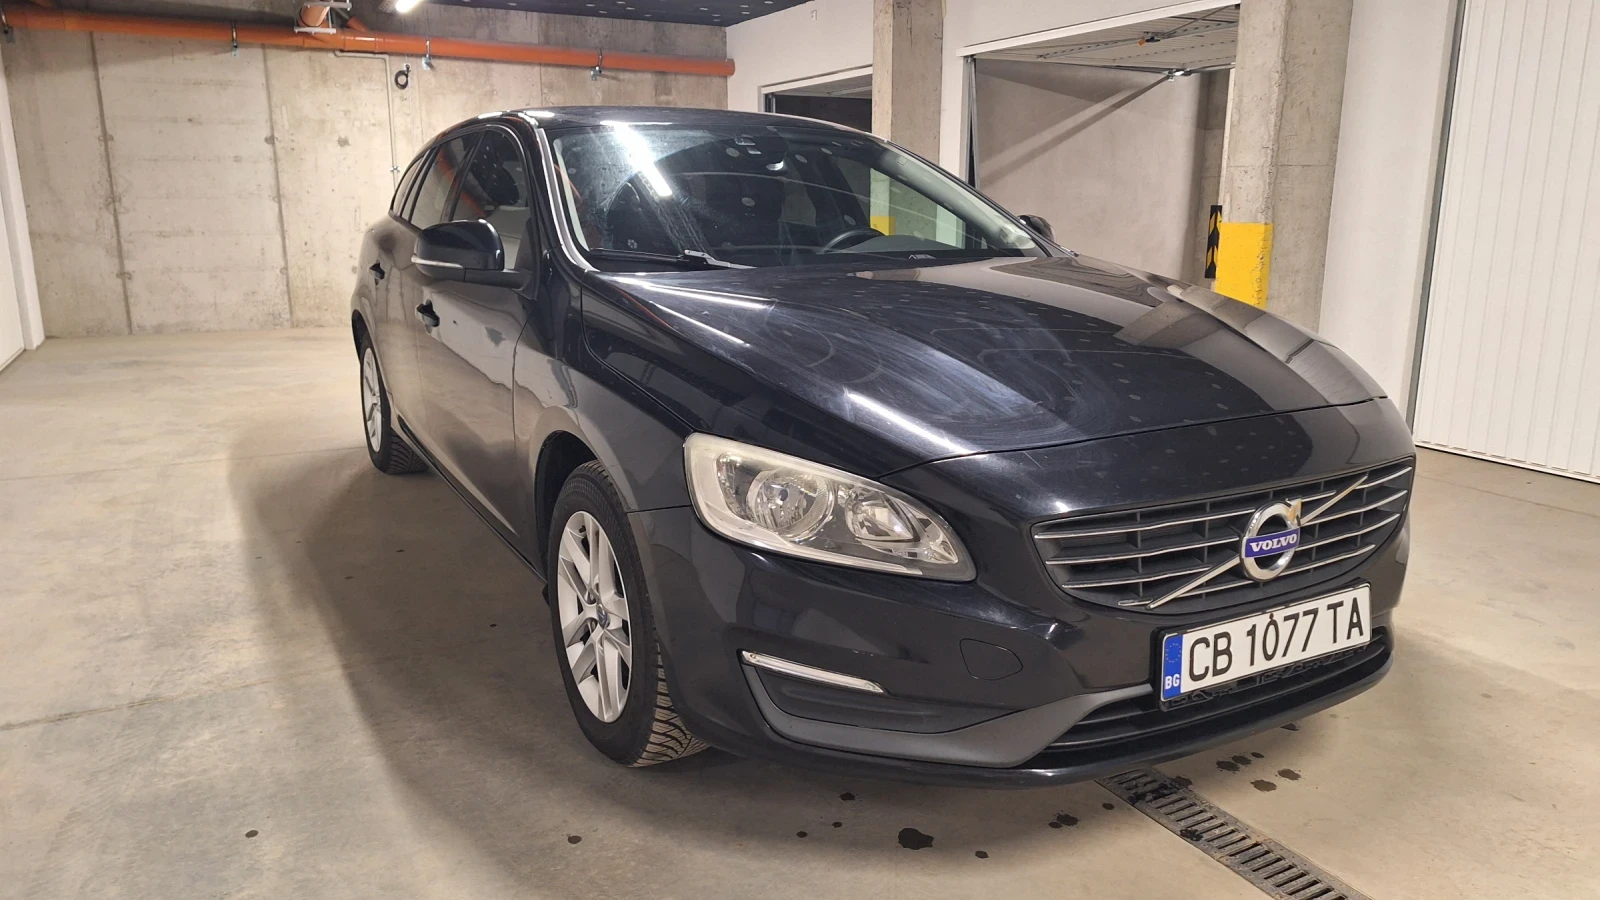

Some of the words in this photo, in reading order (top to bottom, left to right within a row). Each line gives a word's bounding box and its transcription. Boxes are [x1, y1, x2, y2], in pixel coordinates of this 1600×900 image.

[1250, 533, 1298, 552] VOLVO
[1189, 631, 1233, 682] CB
[1246, 607, 1319, 666] 1077
[1327, 597, 1364, 643] TA
[1165, 673, 1180, 690] BG
